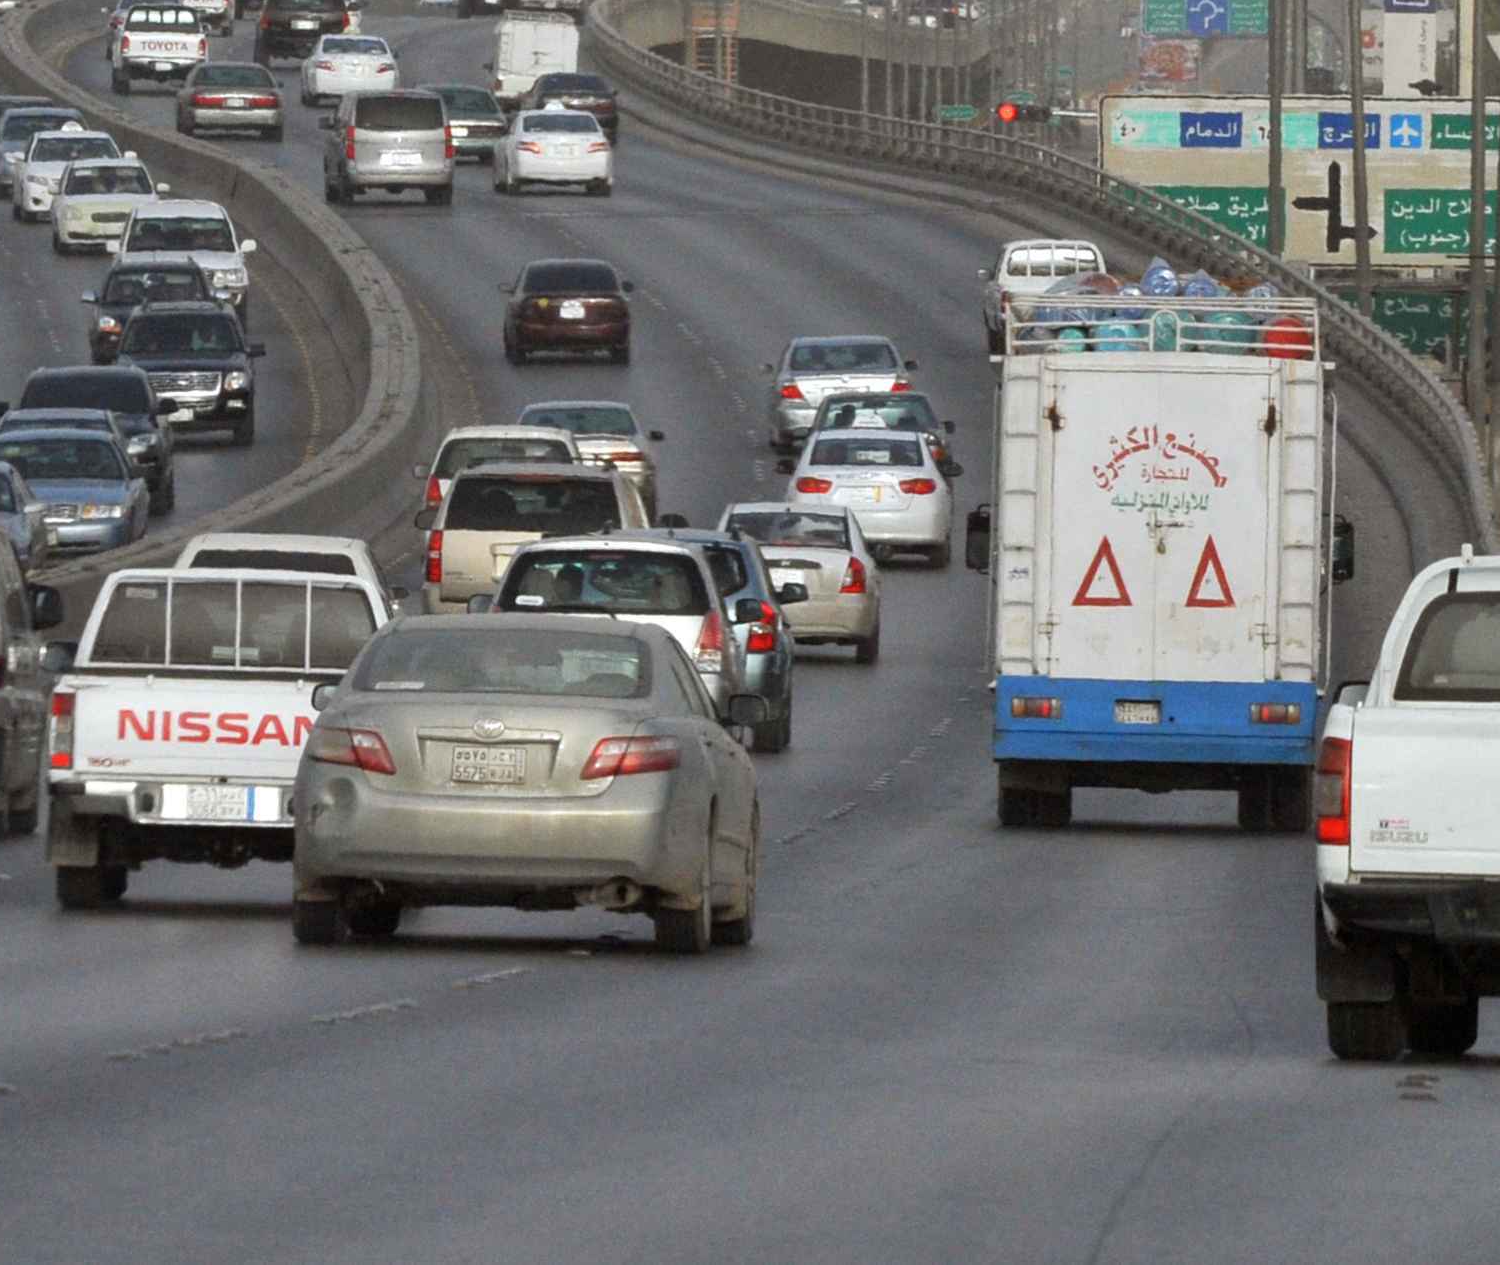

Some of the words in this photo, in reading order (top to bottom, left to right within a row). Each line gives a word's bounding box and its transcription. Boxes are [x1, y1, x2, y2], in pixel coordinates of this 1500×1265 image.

[140, 40, 189, 52] TOYOTA
[1185, 121, 1238, 143] الدمام
[1391, 198, 1440, 220] الدين
[1399, 228, 1470, 249] (جنوب)
[1161, 432, 1228, 489] مصنع
[1140, 462, 1190, 484] للتجارة
[116, 709, 317, 748] NISSAN
[453, 765, 487, 782] 5575
